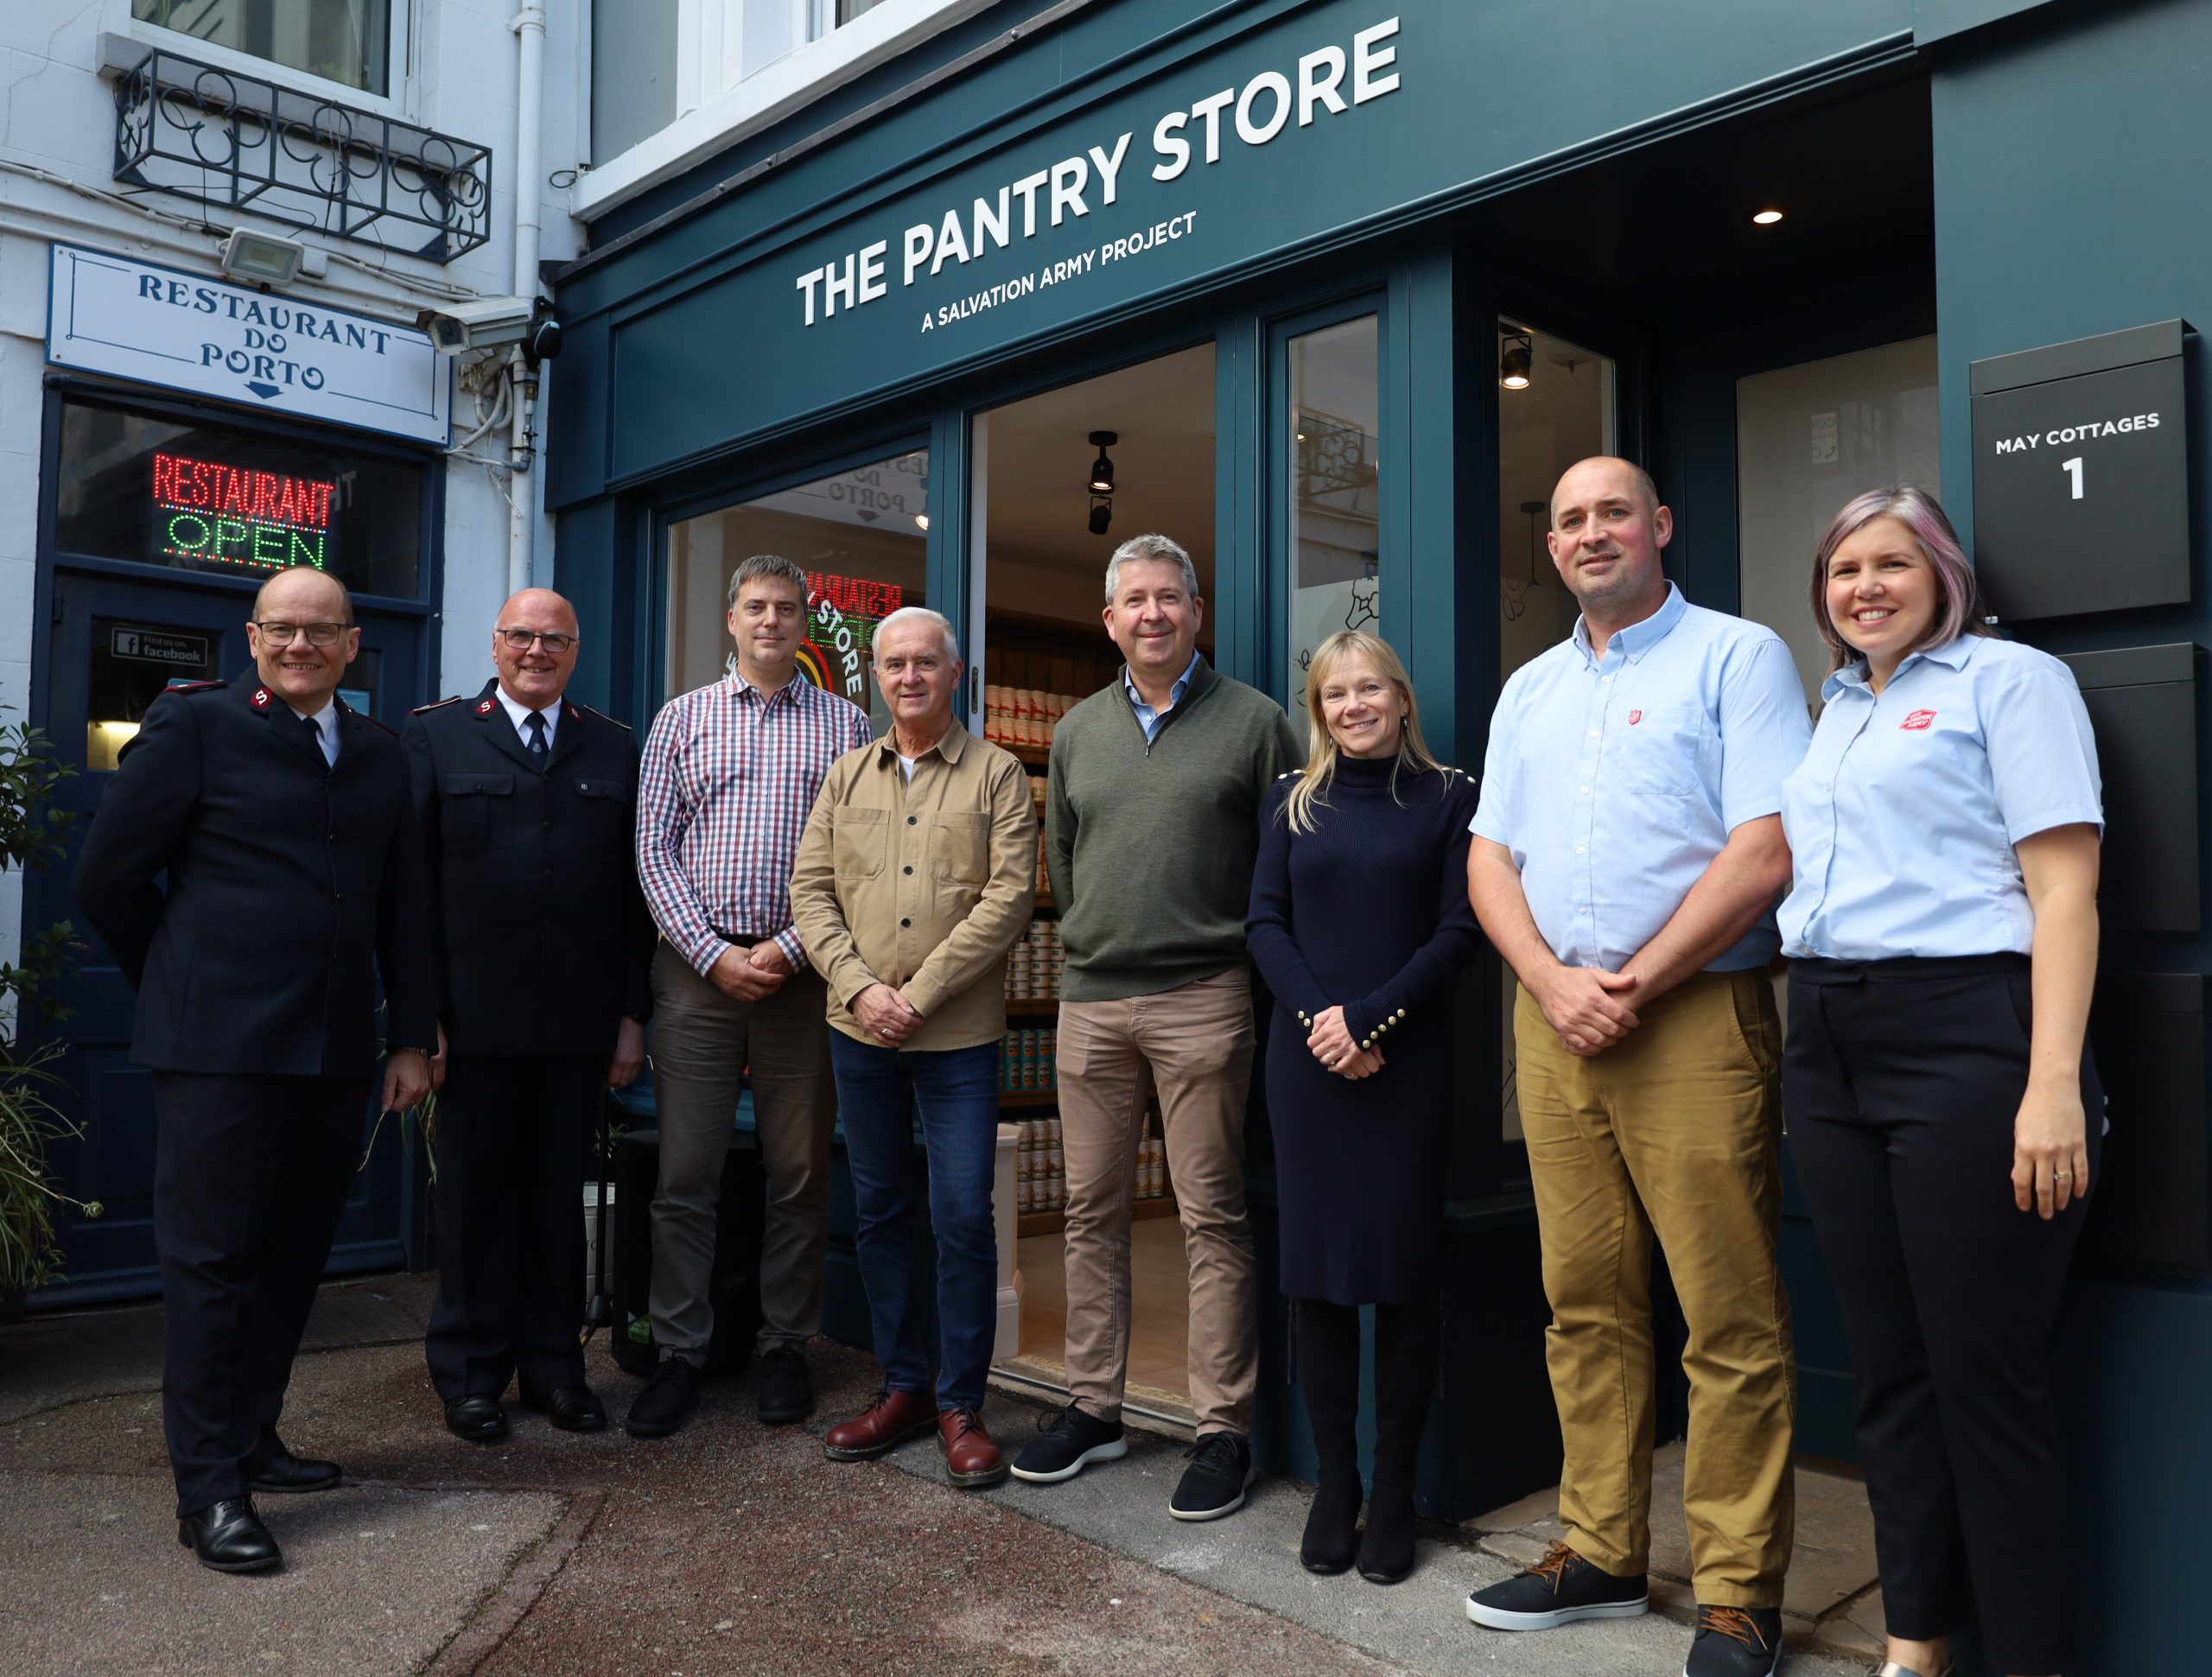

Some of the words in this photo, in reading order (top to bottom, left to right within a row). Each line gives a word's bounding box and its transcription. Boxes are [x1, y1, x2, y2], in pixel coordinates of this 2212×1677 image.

[797, 239, 887, 327] THE
[904, 132, 1134, 286] PANTRY
[1151, 16, 1401, 181] STORE
[921, 313, 934, 333] A
[938, 273, 1034, 327] SALVATION
[1039, 250, 1096, 289] ARMY
[1102, 211, 1197, 266] PROJECT
[138, 274, 391, 356] RESTAURANT
[244, 327, 287, 353] DO
[200, 342, 325, 391] PORTO
[1995, 433, 2040, 454] MAY
[2046, 412, 2160, 446] COTTAGES
[153, 454, 336, 526] RESTAURANT
[2062, 456, 2083, 499] 1
[168, 513, 325, 570] OPEN
[143, 635, 163, 645] Find
[143, 645, 200, 662] facebook
[817, 600, 862, 697] STORE
